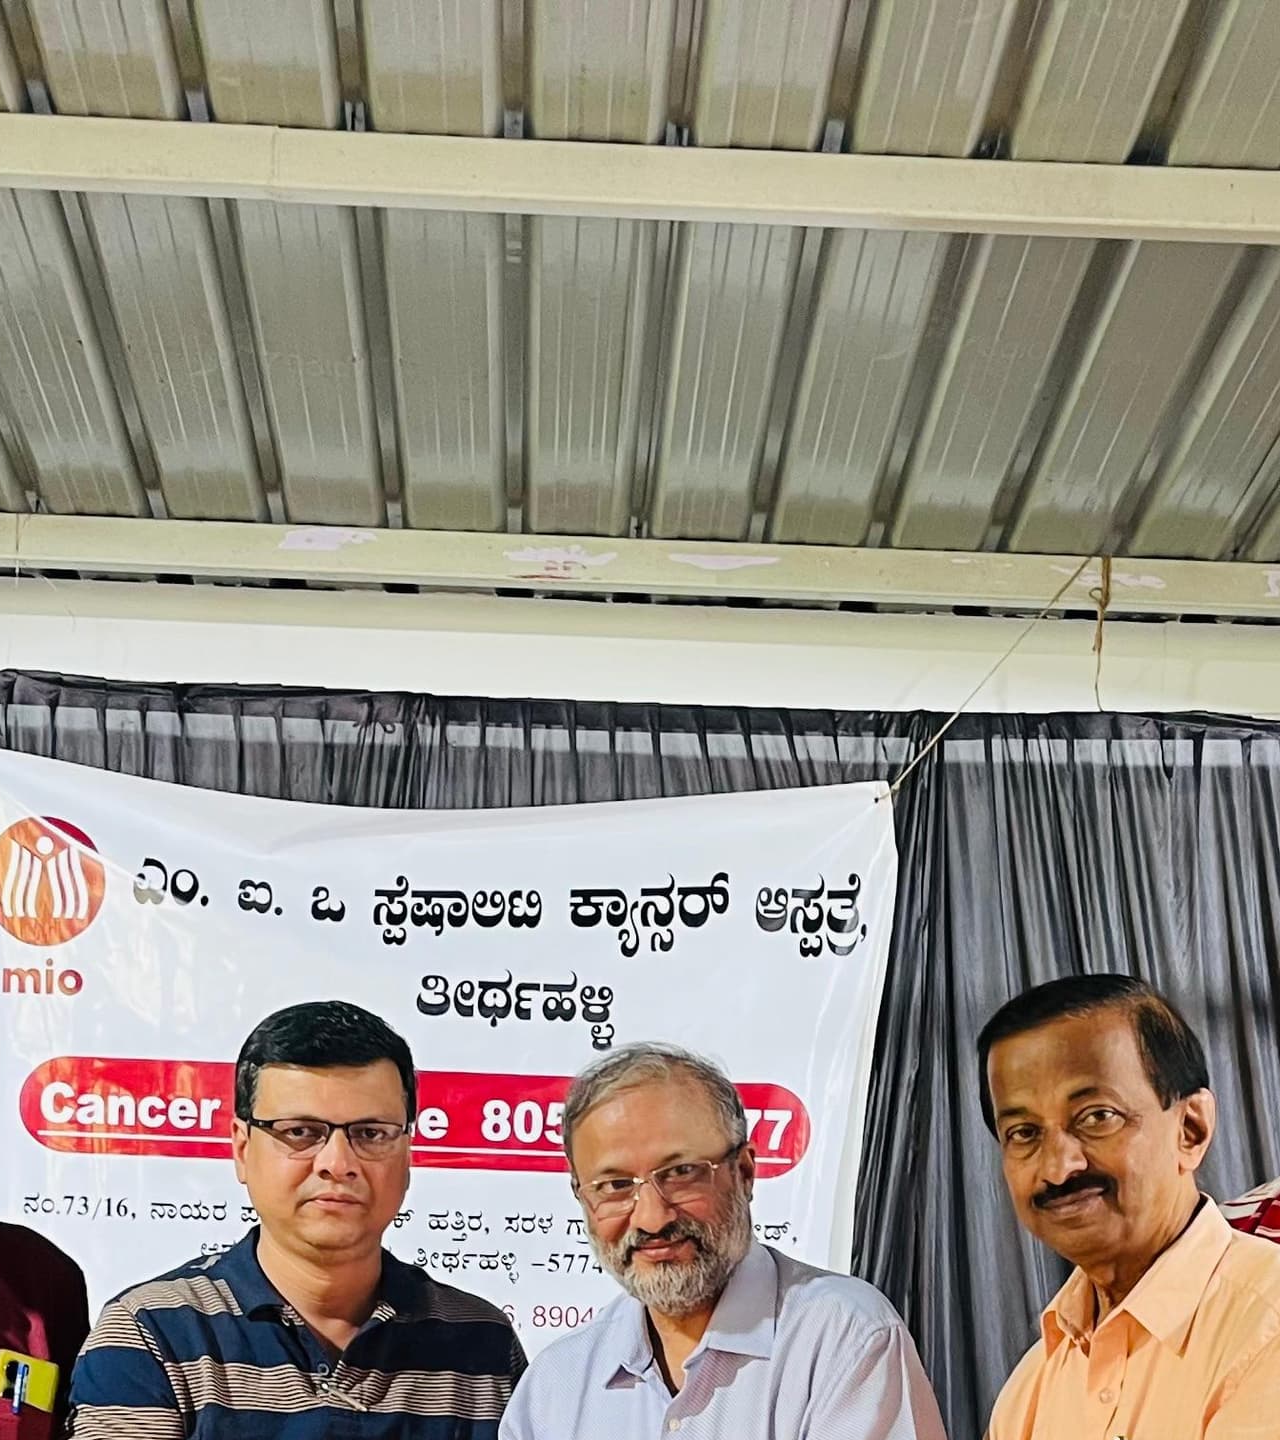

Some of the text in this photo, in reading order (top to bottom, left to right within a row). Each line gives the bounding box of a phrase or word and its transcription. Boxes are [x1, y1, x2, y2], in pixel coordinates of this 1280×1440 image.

[570, 872, 729, 958] ಕ್ಯಾನ್ಸರ್
[2, 958, 83, 996] mio
[416, 969, 615, 1050] ತೀರ್ಥಹಳ್ಳಿ
[40, 1081, 222, 1130] Cancer
[150, 1200, 228, 1221] ನಾಯರ
[532, 1305, 594, 1329] 8904
